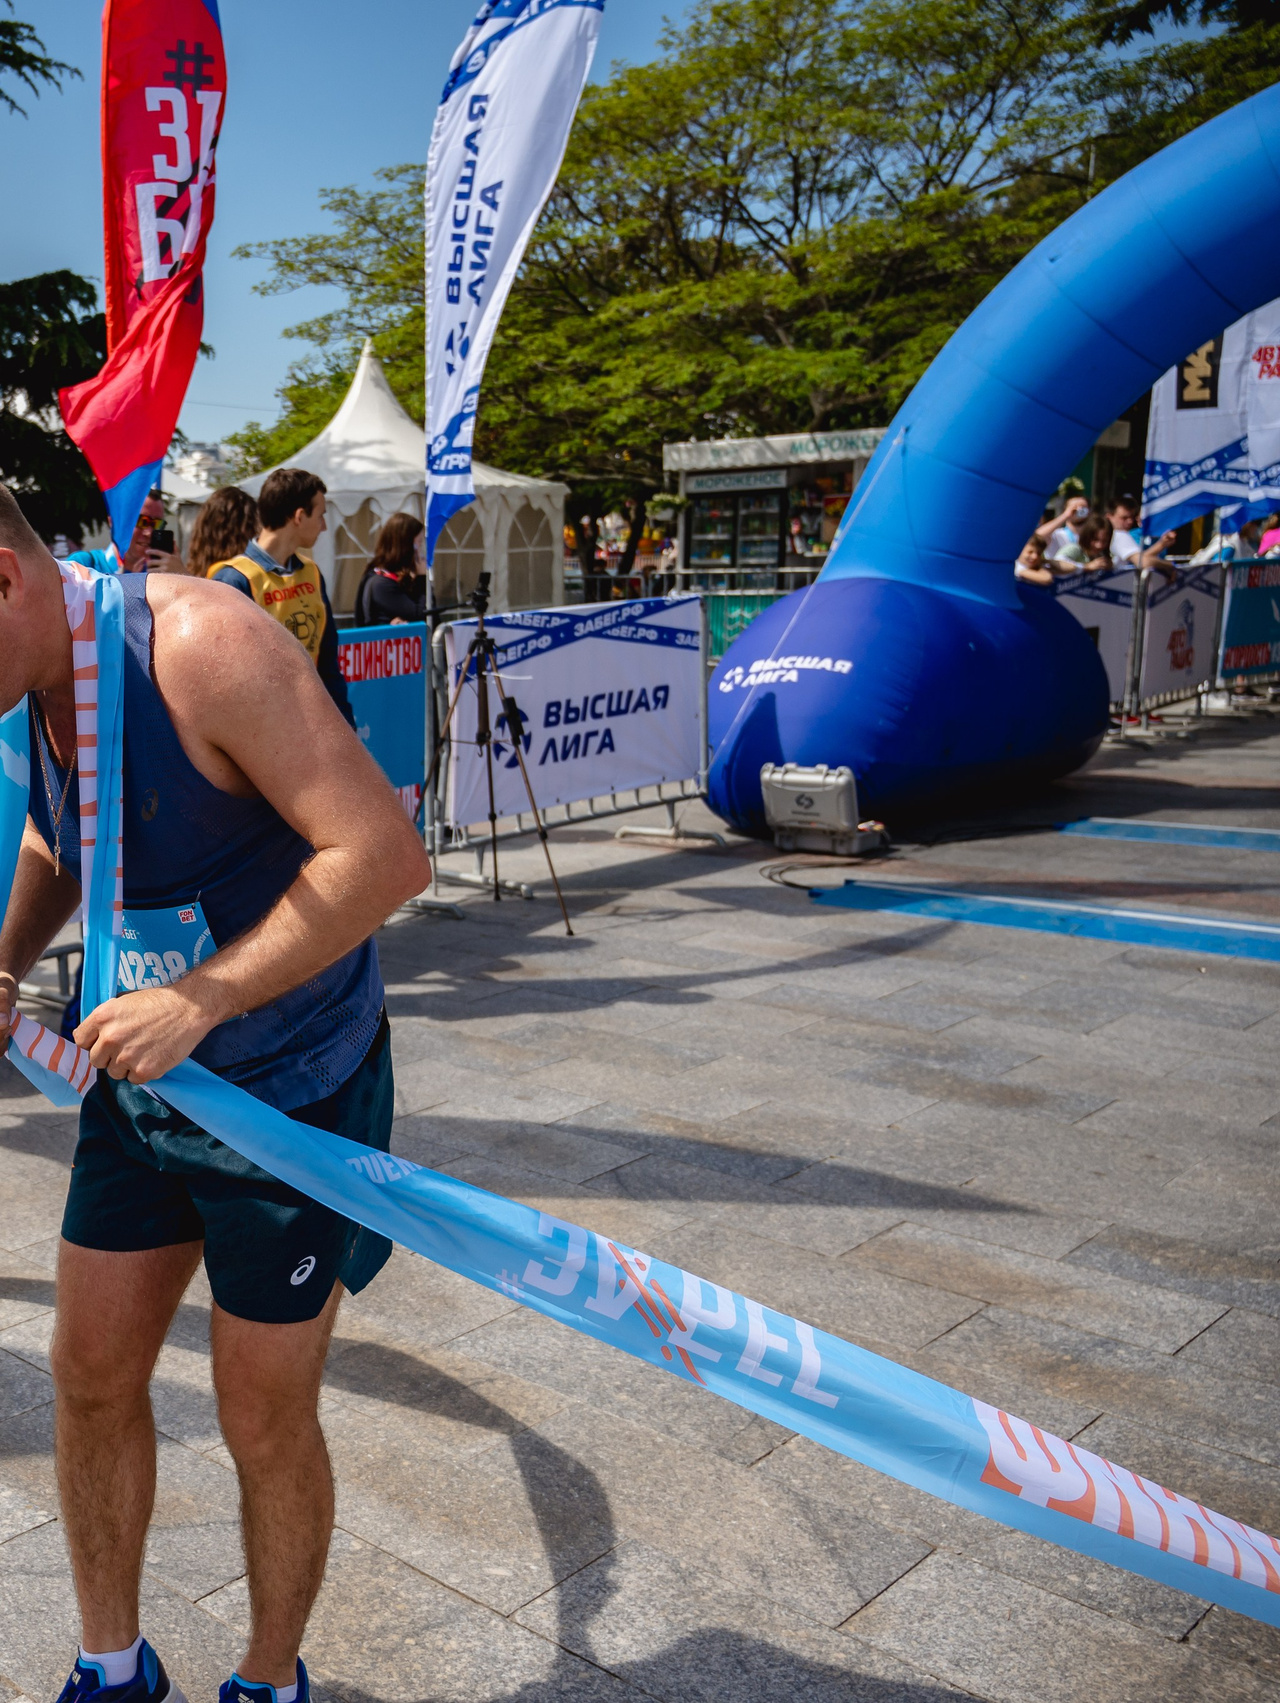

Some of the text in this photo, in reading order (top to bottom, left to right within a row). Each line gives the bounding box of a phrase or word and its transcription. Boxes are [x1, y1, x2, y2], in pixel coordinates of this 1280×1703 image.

[446, 93, 490, 305] ВЫСШАЯ
[466, 179, 504, 308] ЛИГА
[693, 472, 782, 490] МОРОЖЕНОЕ
[573, 603, 645, 637] ЗАБЕГ.РФ
[495, 634, 552, 666] БЕГ.РФ
[748, 656, 853, 674] ВЫСШАЯ
[740, 669, 799, 688] ЛИГА
[542, 684, 671, 728] ВЫСШАЯ
[538, 727, 616, 767] ЛИГА
[179, 909, 193, 917] FON
[181, 914, 194, 922] BET
